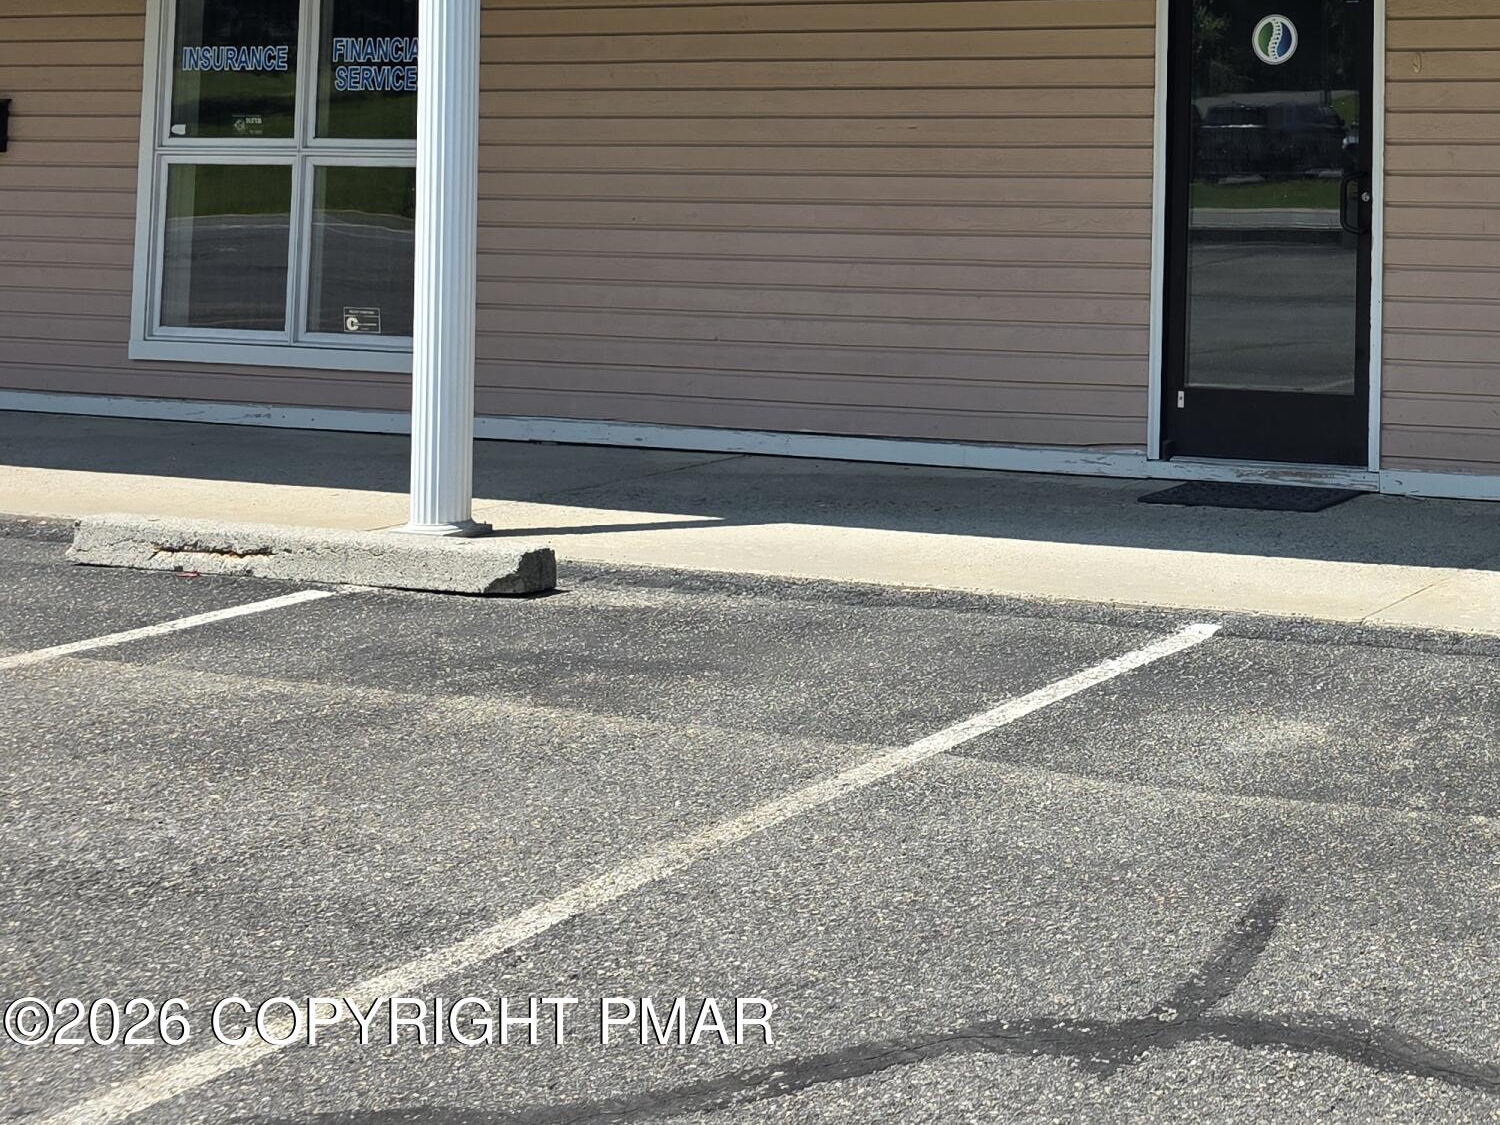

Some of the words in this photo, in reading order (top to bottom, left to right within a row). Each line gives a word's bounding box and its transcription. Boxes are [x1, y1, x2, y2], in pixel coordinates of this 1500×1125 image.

[181, 45, 288, 71] INSURANCE
[332, 37, 419, 63] FINANCIA
[334, 66, 418, 92] SERVICE
